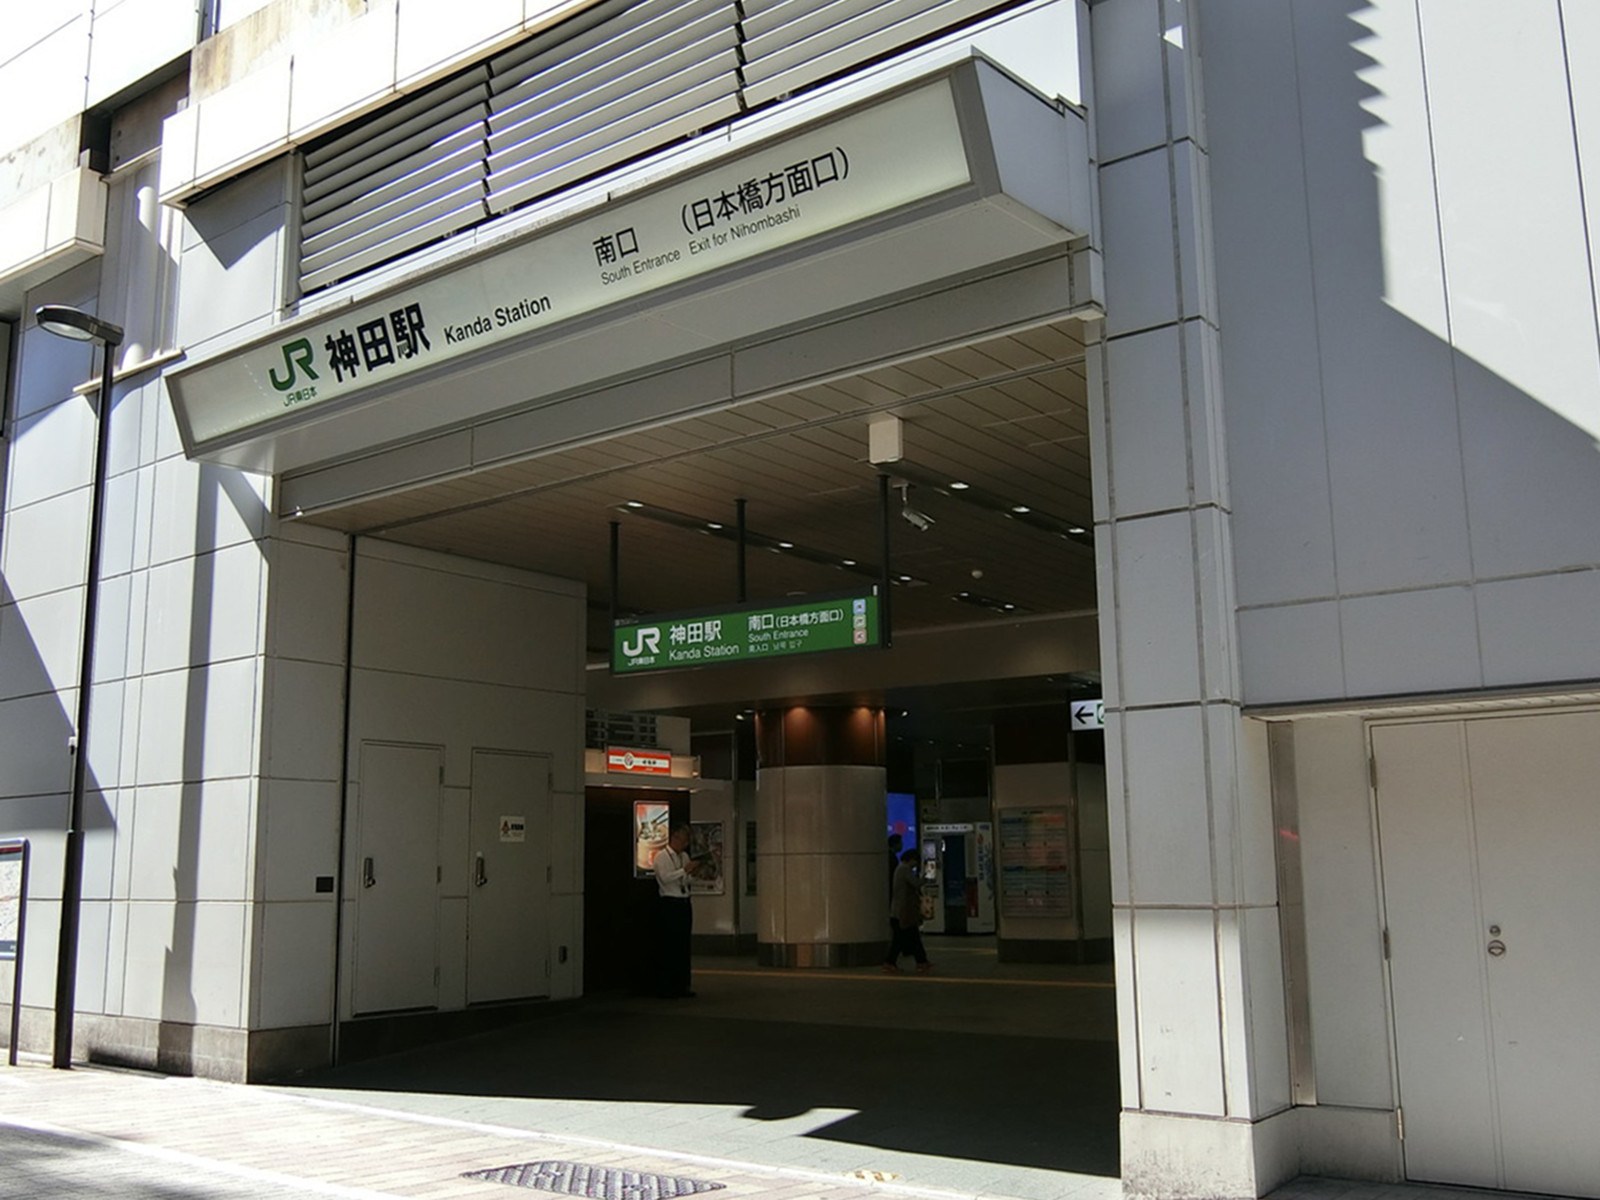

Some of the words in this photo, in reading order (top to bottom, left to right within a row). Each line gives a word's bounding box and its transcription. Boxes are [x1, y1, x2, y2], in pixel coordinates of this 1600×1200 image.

[592, 227, 640, 267] 南口
[600, 265, 632, 286] South
[634, 248, 681, 275] Entrance
[688, 239, 712, 255] Exit
[712, 231, 728, 248] for
[731, 204, 801, 240] Nihombashi
[443, 316, 493, 345] Kanda
[494, 295, 552, 328] Station
[325, 302, 431, 384] 神田駅
[268, 337, 320, 392] JR
[283, 386, 318, 407] JR東日本
[622, 627, 661, 657] JR
[669, 619, 722, 646] 神田駅
[748, 632, 772, 643] South
[773, 629, 809, 640] Entrance
[669, 647, 701, 661] Kanda
[703, 644, 739, 658] Station
